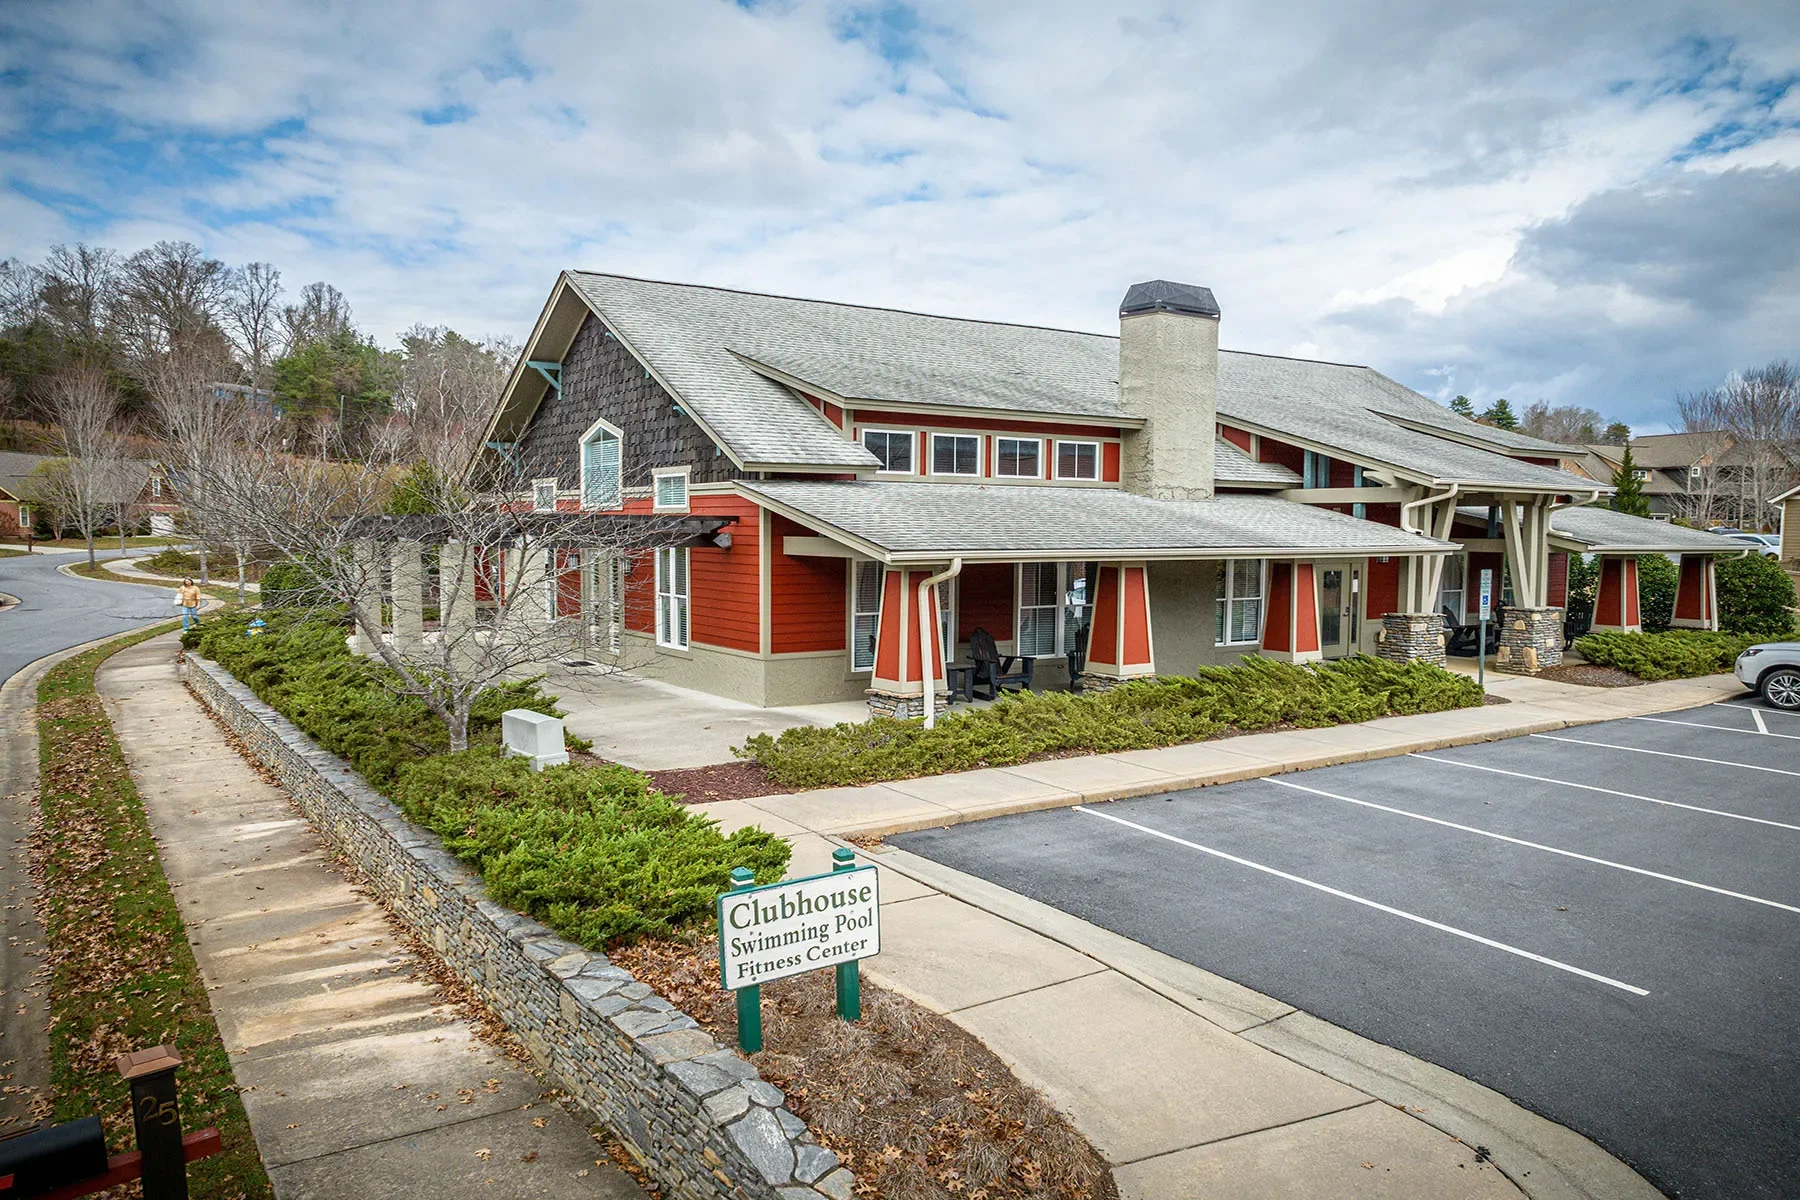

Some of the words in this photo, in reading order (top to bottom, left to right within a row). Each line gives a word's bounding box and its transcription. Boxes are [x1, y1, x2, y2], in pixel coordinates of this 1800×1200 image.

[729, 885, 872, 930] Clubhouse
[731, 922, 829, 958] Swimming
[835, 907, 873, 934] Pool
[737, 954, 801, 979] Fitness
[806, 938, 868, 961] Center
[139, 1096, 178, 1126] 25
